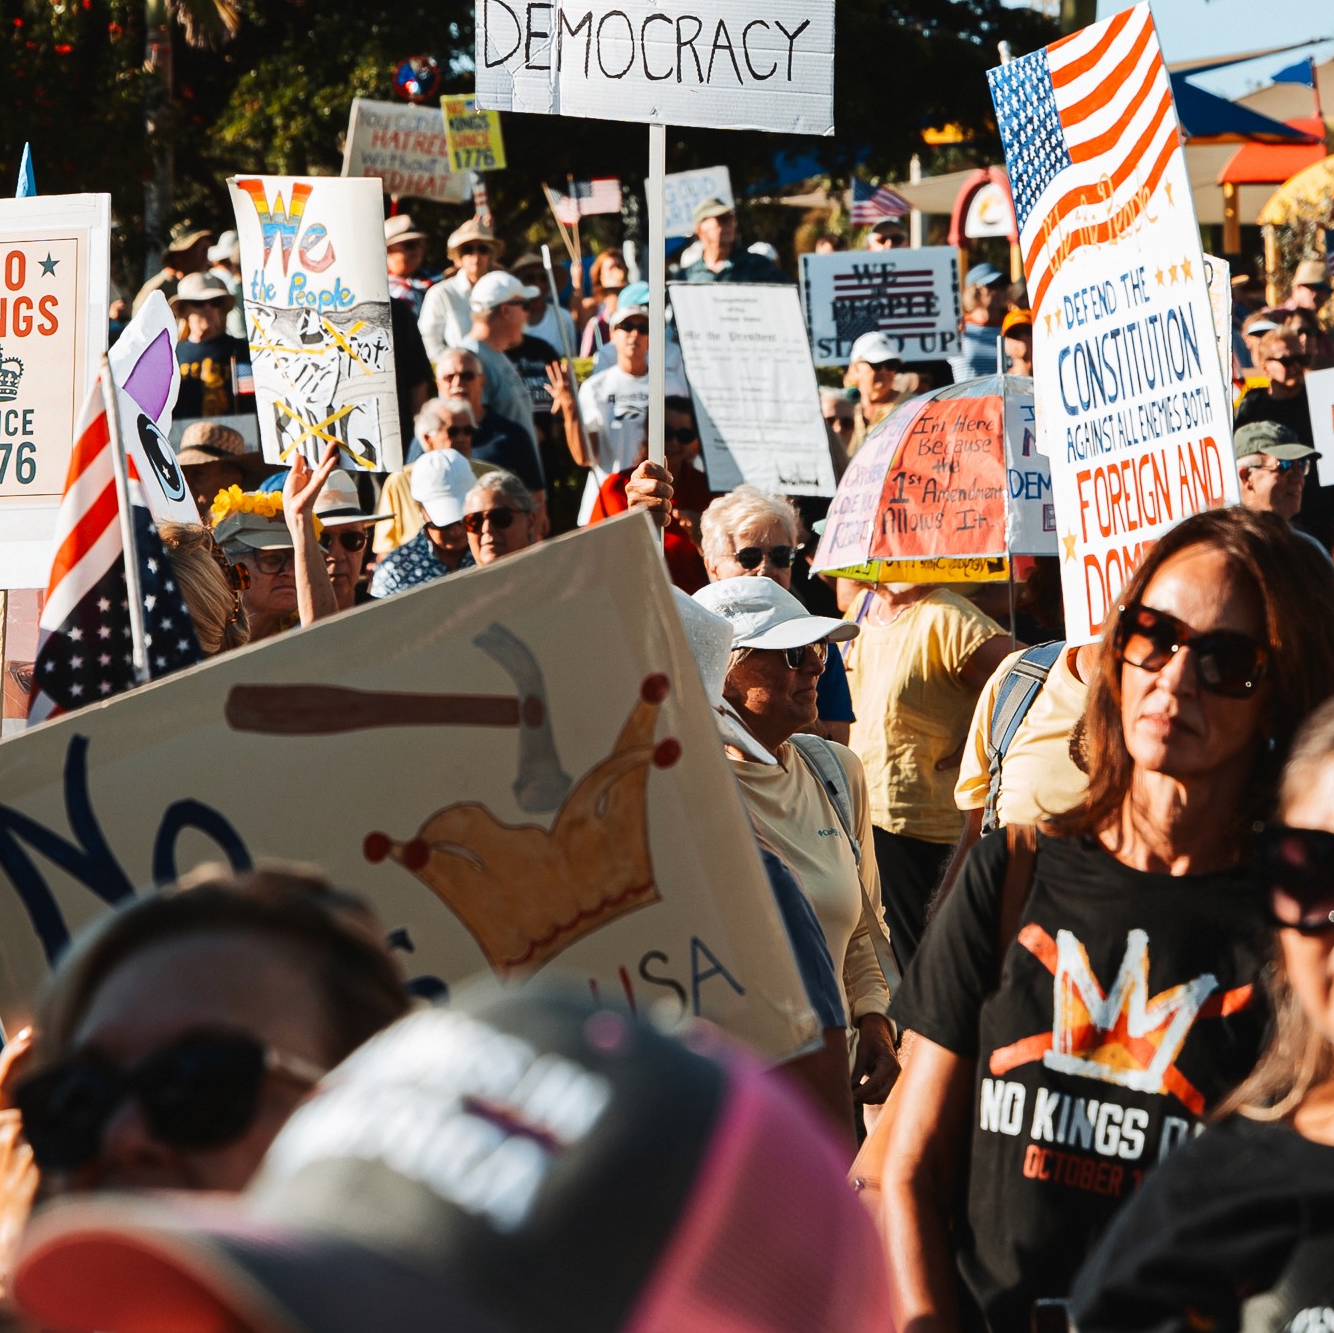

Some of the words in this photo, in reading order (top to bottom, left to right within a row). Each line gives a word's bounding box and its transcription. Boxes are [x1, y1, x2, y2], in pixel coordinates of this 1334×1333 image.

[454, 148, 496, 169] 1776
[237, 178, 336, 278] We
[251, 268, 277, 303] the
[288, 271, 356, 315] People
[852, 262, 898, 285] WE
[830, 294, 941, 322] PEOPLE
[1063, 279, 1117, 330] DEFEND
[1119, 265, 1151, 309] THE
[818, 333, 905, 359] STD
[919, 331, 956, 354] UP
[1058, 301, 1203, 416] CONSTITUTION
[952, 414, 996, 434] Here
[1066, 414, 1117, 464] AGAINST
[1117, 407, 1139, 446] ALL
[1137, 393, 1183, 442] ENEMIES
[1181, 385, 1214, 431] BOTH
[917, 437, 993, 457] Because
[931, 456, 962, 474] the
[888, 470, 923, 505] 1st
[1075, 448, 1174, 544] FOREIGN
[1176, 435, 1226, 518] AND
[979, 1077, 1027, 1137] NO
[1030, 1086, 1150, 1161] KINGS
[1022, 1143, 1126, 1199] OCTOBER
